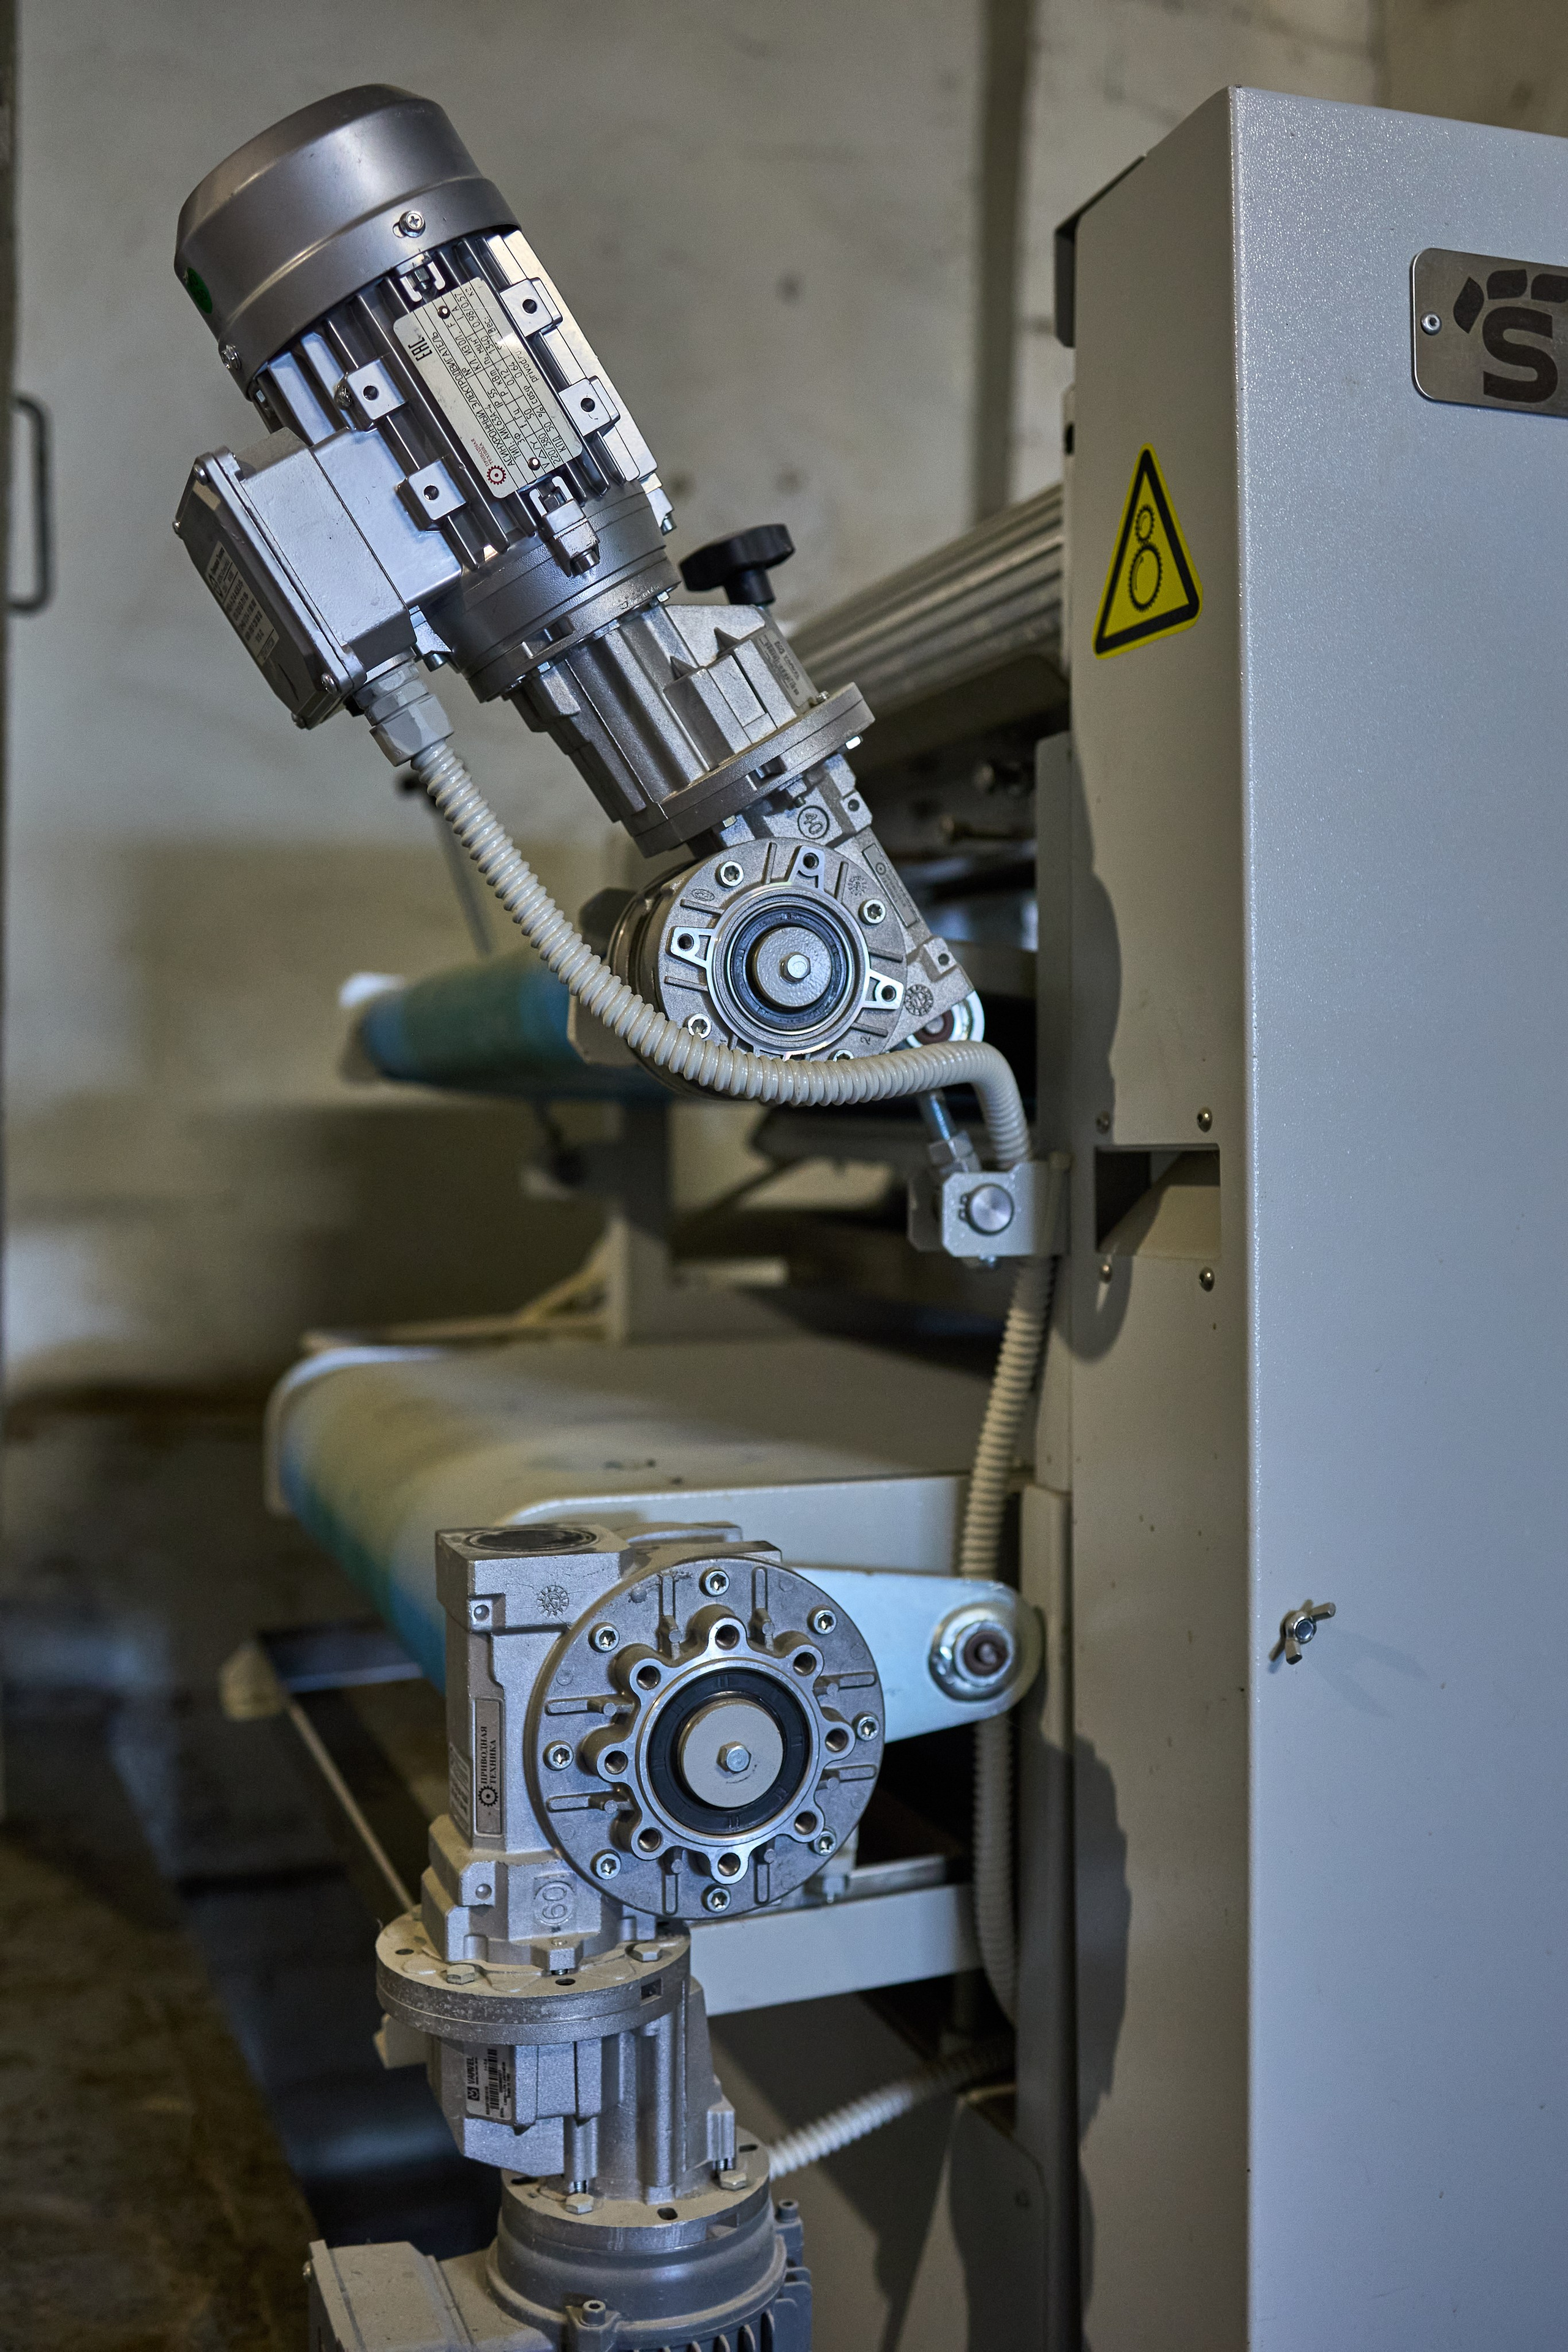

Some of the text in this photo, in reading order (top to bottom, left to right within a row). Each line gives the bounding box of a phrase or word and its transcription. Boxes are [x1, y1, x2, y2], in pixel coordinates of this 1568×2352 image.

[454, 293, 482, 328] 0,98/0,57
[484, 316, 496, 334] Вес:
[407, 336, 432, 361] EAC
[454, 331, 472, 355] ИЗОЛ.
[480, 335, 495, 353] 1340
[469, 355, 481, 371] КЛ.
[508, 361, 522, 378] 0,64
[515, 350, 539, 383] privod.ru
[500, 368, 514, 385] 0,12
[431, 331, 514, 466] АСИНХРОННЫЙ ЭЛЕКТРОДВИГАТЕЛЬ
[487, 388, 497, 398] 55
[513, 408, 522, 420] Гц
[523, 408, 534, 420] 50
[536, 407, 568, 453] КПД 50 %
[470, 438, 489, 467] ПРИВОДНАЯ
[479, 442, 493, 464] ТЕХНИКА
[508, 441, 521, 460] ТИП:
[538, 432, 560, 464] 220/380
[804, 813, 823, 834] 40
[542, 1887, 567, 1919] 60
